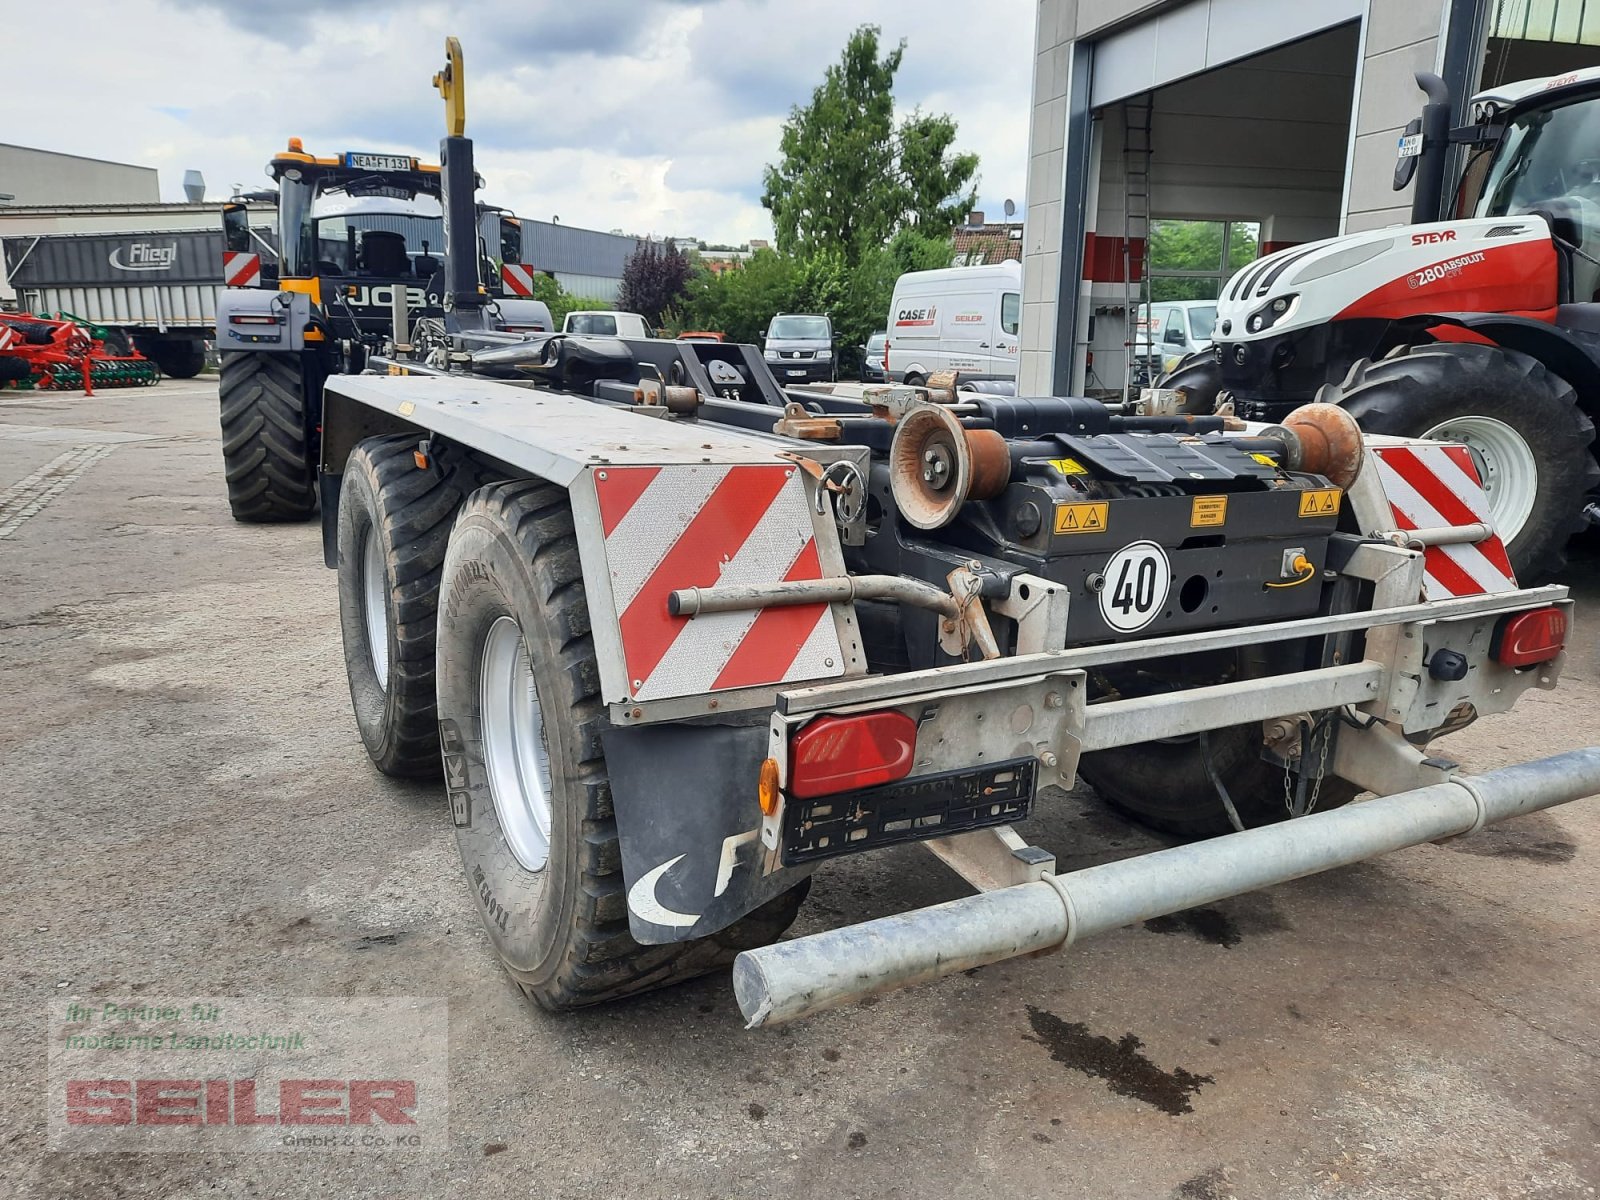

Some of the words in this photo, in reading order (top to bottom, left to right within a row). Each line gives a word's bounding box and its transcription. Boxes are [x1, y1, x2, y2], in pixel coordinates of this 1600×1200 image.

[352, 156, 371, 167] NEA
[378, 158, 388, 168] FT
[391, 159, 409, 169] 131
[1411, 230, 1457, 246] STEYR
[129, 242, 177, 265] Fliegl
[1443, 253, 1486, 271] ABSOLUT
[898, 310, 926, 320] CASE
[1111, 557, 1157, 614] 40
[440, 720, 470, 826] BKT
